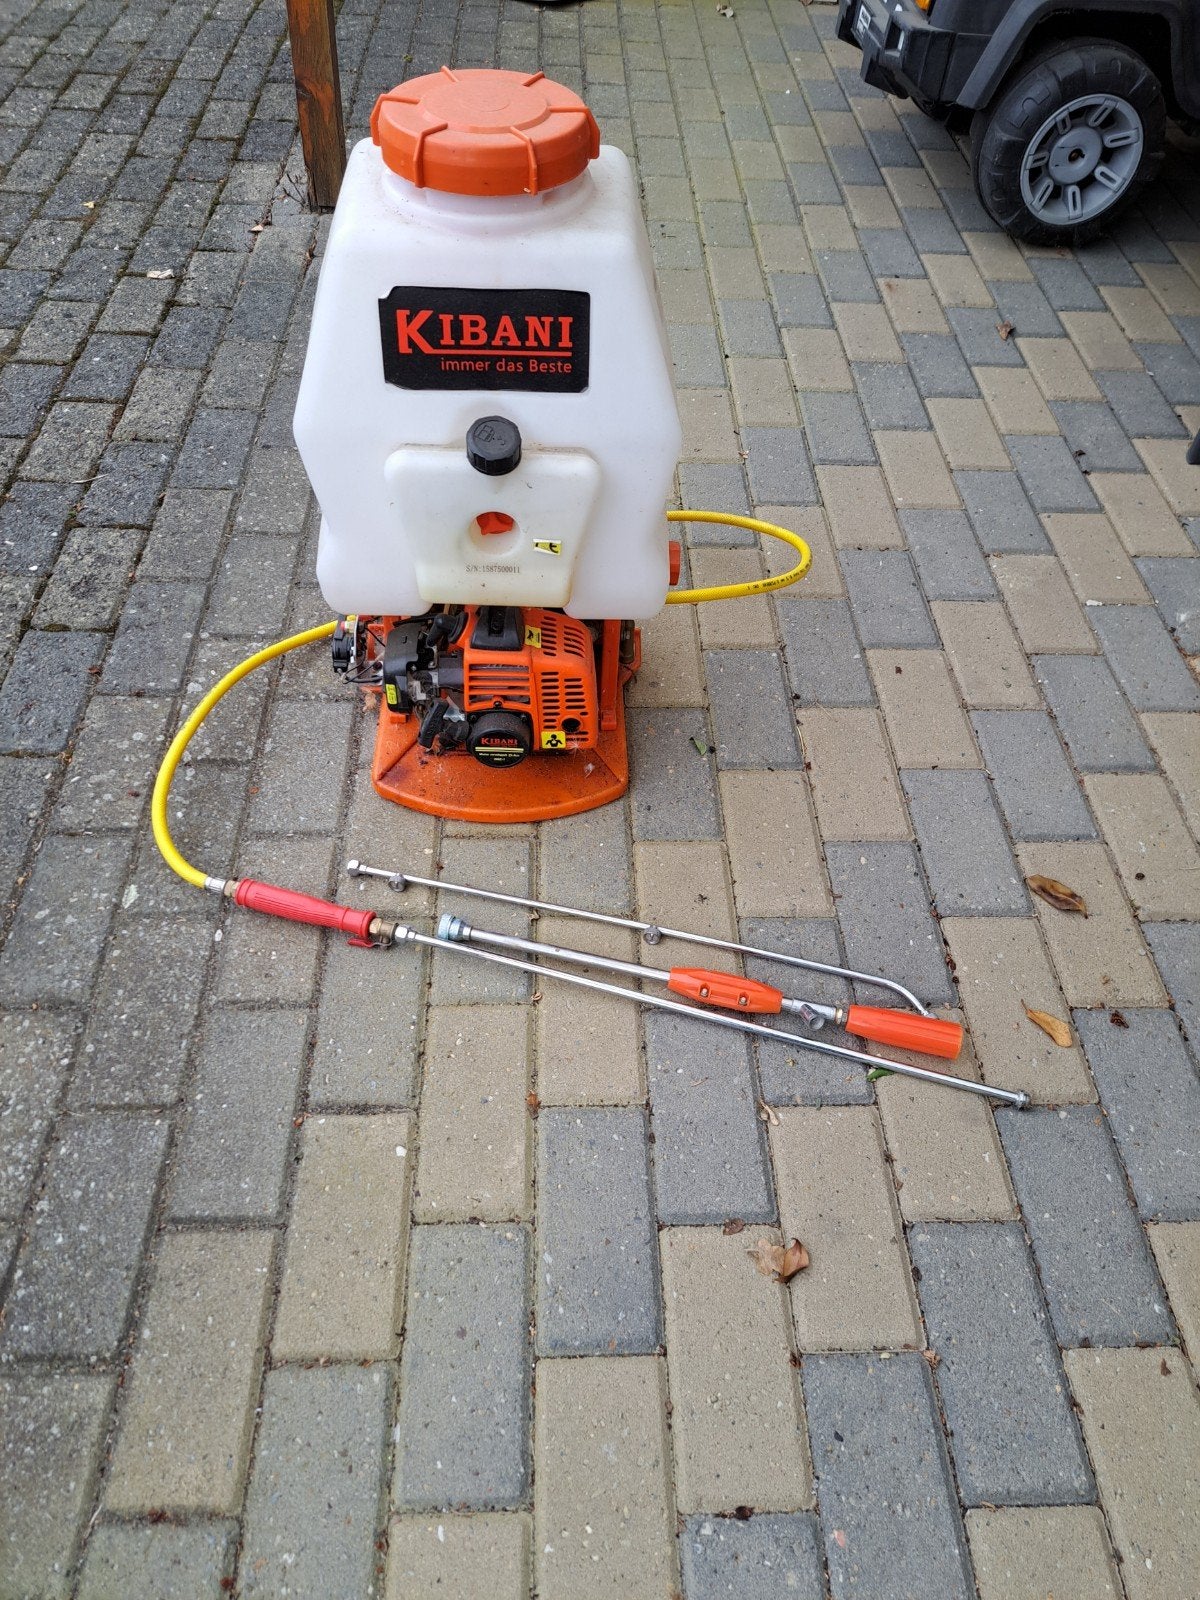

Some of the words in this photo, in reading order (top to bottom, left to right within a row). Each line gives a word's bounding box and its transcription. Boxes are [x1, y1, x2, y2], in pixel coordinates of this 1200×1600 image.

[396, 309, 573, 356] KIBANI
[441, 357, 490, 372] immer
[496, 358, 524, 373] das
[529, 359, 572, 374] Beste
